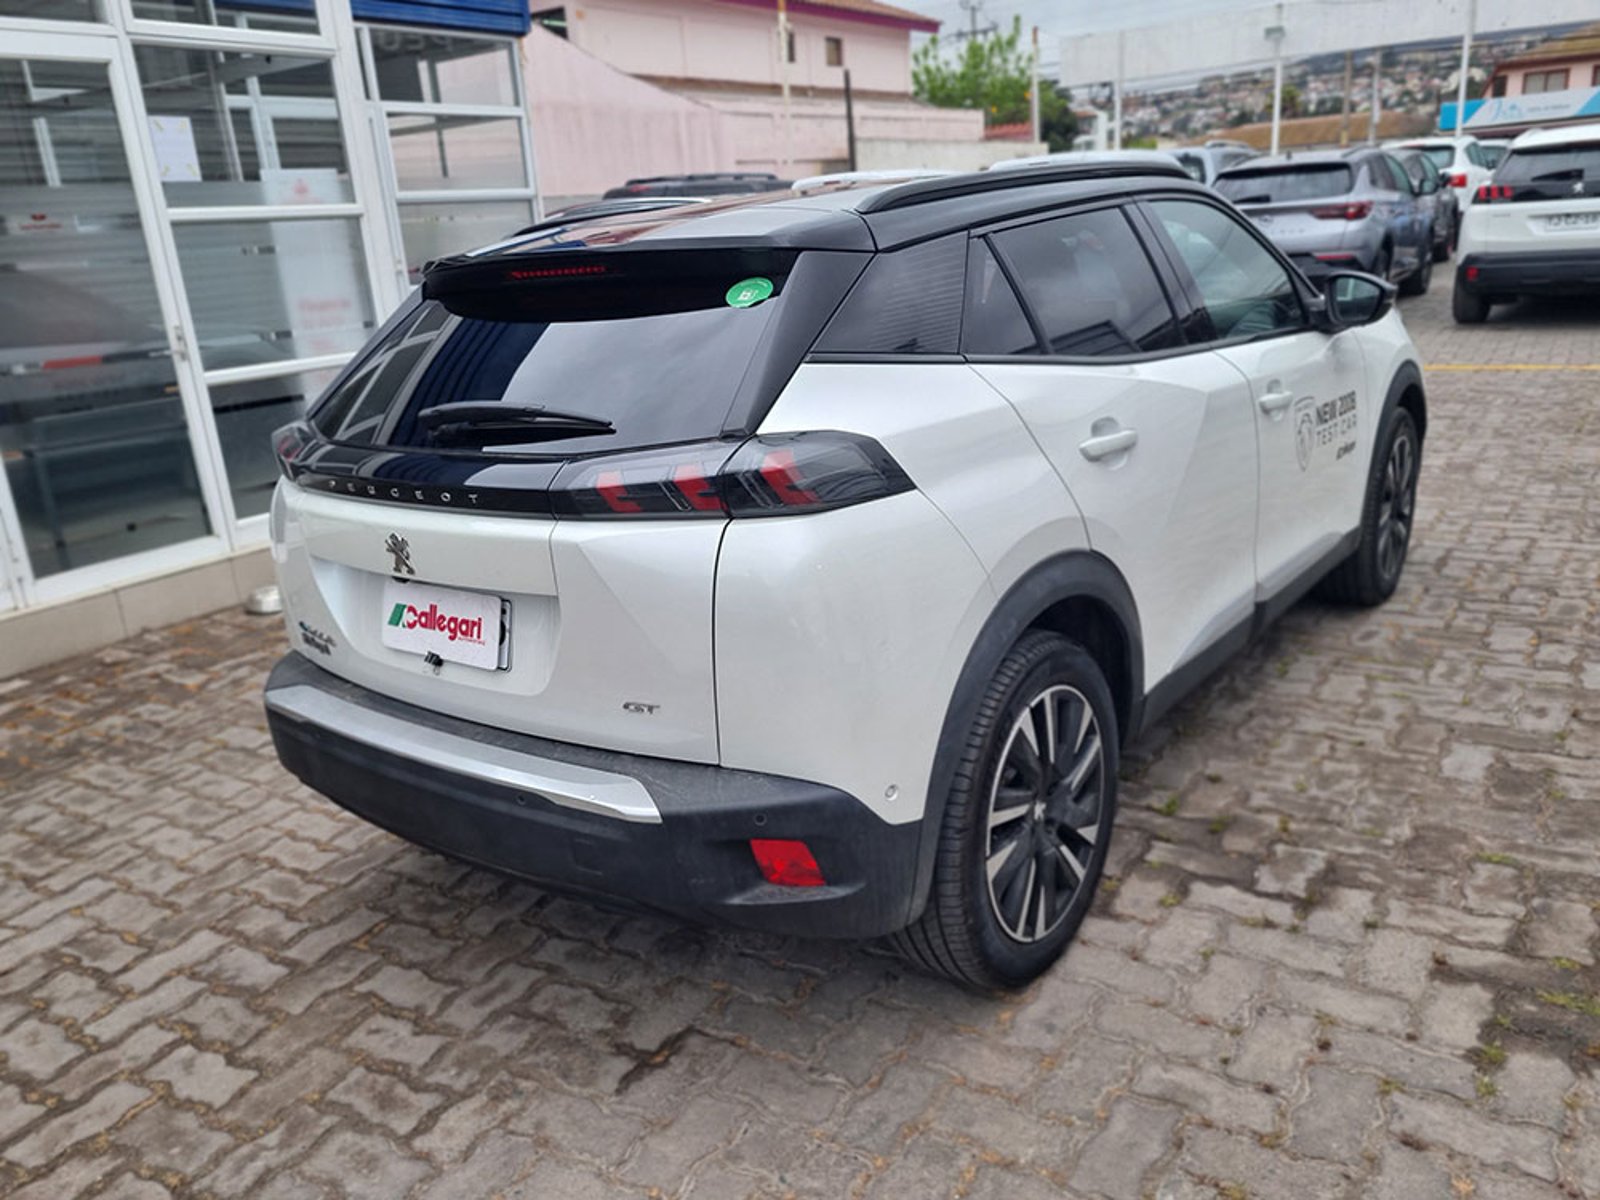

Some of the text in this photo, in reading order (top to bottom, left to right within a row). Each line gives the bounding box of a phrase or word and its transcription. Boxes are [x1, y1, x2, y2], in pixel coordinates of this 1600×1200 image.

[1316, 399, 1337, 426] NEW
[1316, 413, 1357, 448] TEST CAR
[328, 480, 478, 503] PEUGEOT
[406, 603, 482, 641] Callegari
[623, 701, 660, 714] GT
